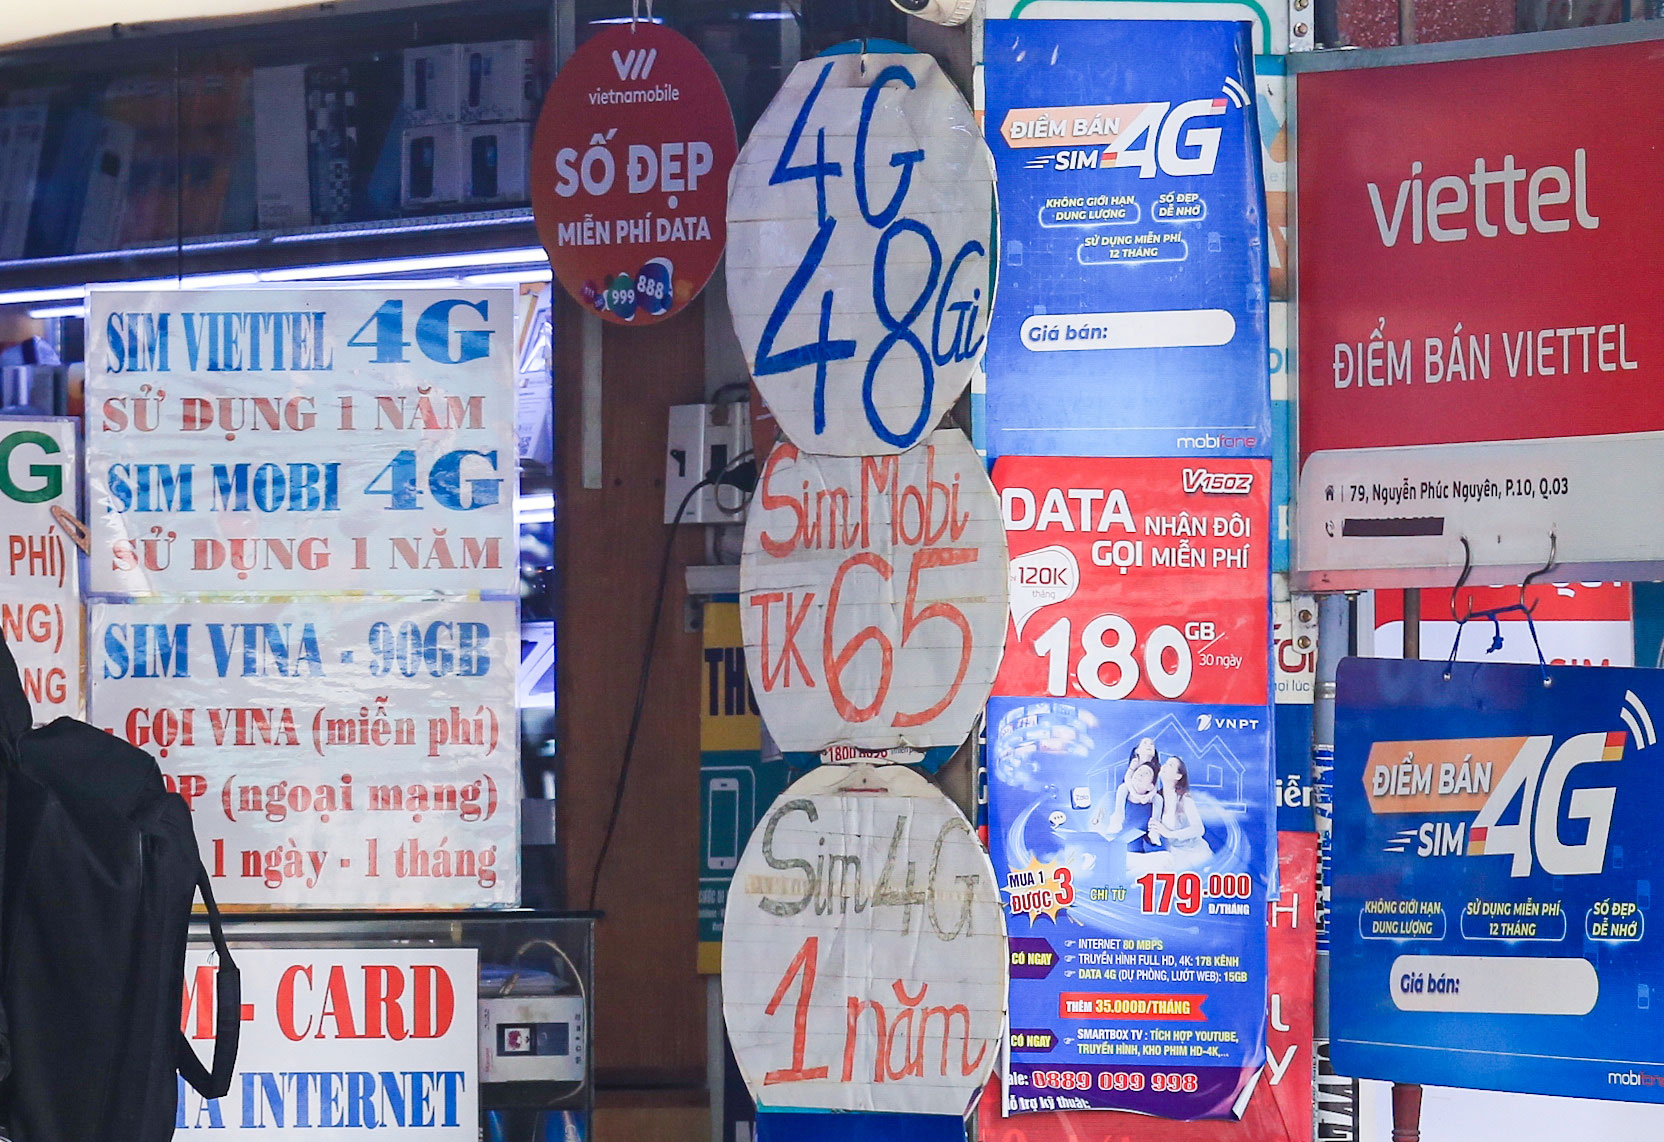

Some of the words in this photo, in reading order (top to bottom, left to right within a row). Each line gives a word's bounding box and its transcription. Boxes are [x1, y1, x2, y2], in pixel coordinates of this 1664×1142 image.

[589, 85, 680, 106] vietnamobile
[769, 61, 926, 229] 4G
[1010, 114, 1067, 140] ĐIỂM
[1074, 117, 1120, 137] BÁN
[1100, 99, 1228, 179] 4G
[1055, 150, 1098, 171] SIM
[555, 128, 616, 197] SỐ
[627, 141, 714, 210] ĐẸP
[1368, 148, 1599, 248] viettel
[558, 214, 609, 246] MIỄN
[616, 213, 650, 243] PHÍ
[657, 216, 711, 242] DATA
[612, 289, 635, 304] 999
[637, 274, 664, 298] 888
[106, 311, 171, 373] SIM
[181, 311, 334, 372] VIETTEL
[347, 299, 496, 365] 4G
[1029, 324, 1059, 342] Giá
[1065, 324, 1108, 340] bán:
[1333, 317, 1411, 389] ĐIỂM
[1425, 323, 1490, 384] BÁN
[1502, 324, 1638, 379] VIETTEL
[103, 384, 167, 432] SỬ
[179, 396, 317, 442] DỤNG
[337, 396, 354, 430] 1
[374, 386, 486, 430] NĂM
[1177, 434, 1256, 448] mobifone
[106, 462, 195, 513] SIM
[210, 461, 342, 512] MOBI
[363, 449, 505, 511] 4G
[1183, 469, 1253, 494] V150Z
[1350, 485, 1369, 503] 79,
[1372, 478, 1416, 503] Nguyễn
[1420, 478, 1449, 499] Phúc
[1453, 479, 1501, 501] Nguyên,
[1506, 480, 1535, 500] P.10,
[1540, 476, 1568, 499] Q.03
[1002, 488, 1136, 532] DATA
[1145, 512, 1208, 537] NHÂN
[1212, 512, 1250, 537] ĐÔI
[10, 526, 65, 588] PHÍ)
[112, 526, 178, 572] SỬ
[191, 536, 332, 580] DỤNG
[351, 536, 371, 570] 1
[389, 528, 503, 570] NĂM
[1019, 567, 1067, 586] 120K
[1092, 541, 1143, 574] GỌI
[1152, 541, 1206, 568] MIỄN
[1212, 544, 1249, 568] PHÍ
[103, 622, 191, 680] SIM
[206, 622, 326, 678] VINA
[368, 621, 491, 677] 90GB
[750, 592, 815, 693] TK
[823, 548, 979, 728] 65
[1034, 614, 1192, 700] 180
[1185, 622, 1215, 640] GB
[1200, 654, 1213, 666] 30
[1215, 654, 1242, 668] ngày
[125, 707, 195, 758] GỌI
[206, 708, 300, 747] VINA
[313, 695, 416, 758] (miễn
[427, 706, 500, 758] phí)
[1215, 718, 1259, 729] VNPT
[221, 773, 354, 823] (ngoại
[367, 773, 498, 823] mạng)
[1372, 752, 1432, 798] ĐIỂM
[1438, 753, 1492, 795] BÁN
[1467, 731, 1626, 878] 4G
[241, 837, 327, 889] ngày
[366, 838, 378, 878] 1
[395, 835, 497, 889] tháng
[1417, 823, 1466, 857] SIM
[1009, 873, 1036, 888] MUA
[1011, 891, 1052, 915] ĐƯỢC
[1053, 867, 1074, 905] 3
[1137, 873, 1251, 915] 179.000
[1209, 902, 1249, 915] Đ/THÁNG
[1078, 939, 1120, 949] INTERNET
[1123, 939, 1134, 949] 80
[1136, 939, 1163, 950] MBPS
[276, 964, 455, 1042] CARD
[1066, 998, 1092, 1012] THÊM
[1095, 997, 1190, 1014] 35.000Đ/THÁNG
[1401, 972, 1423, 994] Giá
[1427, 971, 1460, 994] bán:
[764, 936, 828, 1085] 1
[841, 979, 986, 1083] năm
[240, 1071, 465, 1130] INTERNET
[1032, 1071, 1092, 1090] 0889
[1098, 1072, 1145, 1091] 099
[1151, 1073, 1199, 1092] 998
